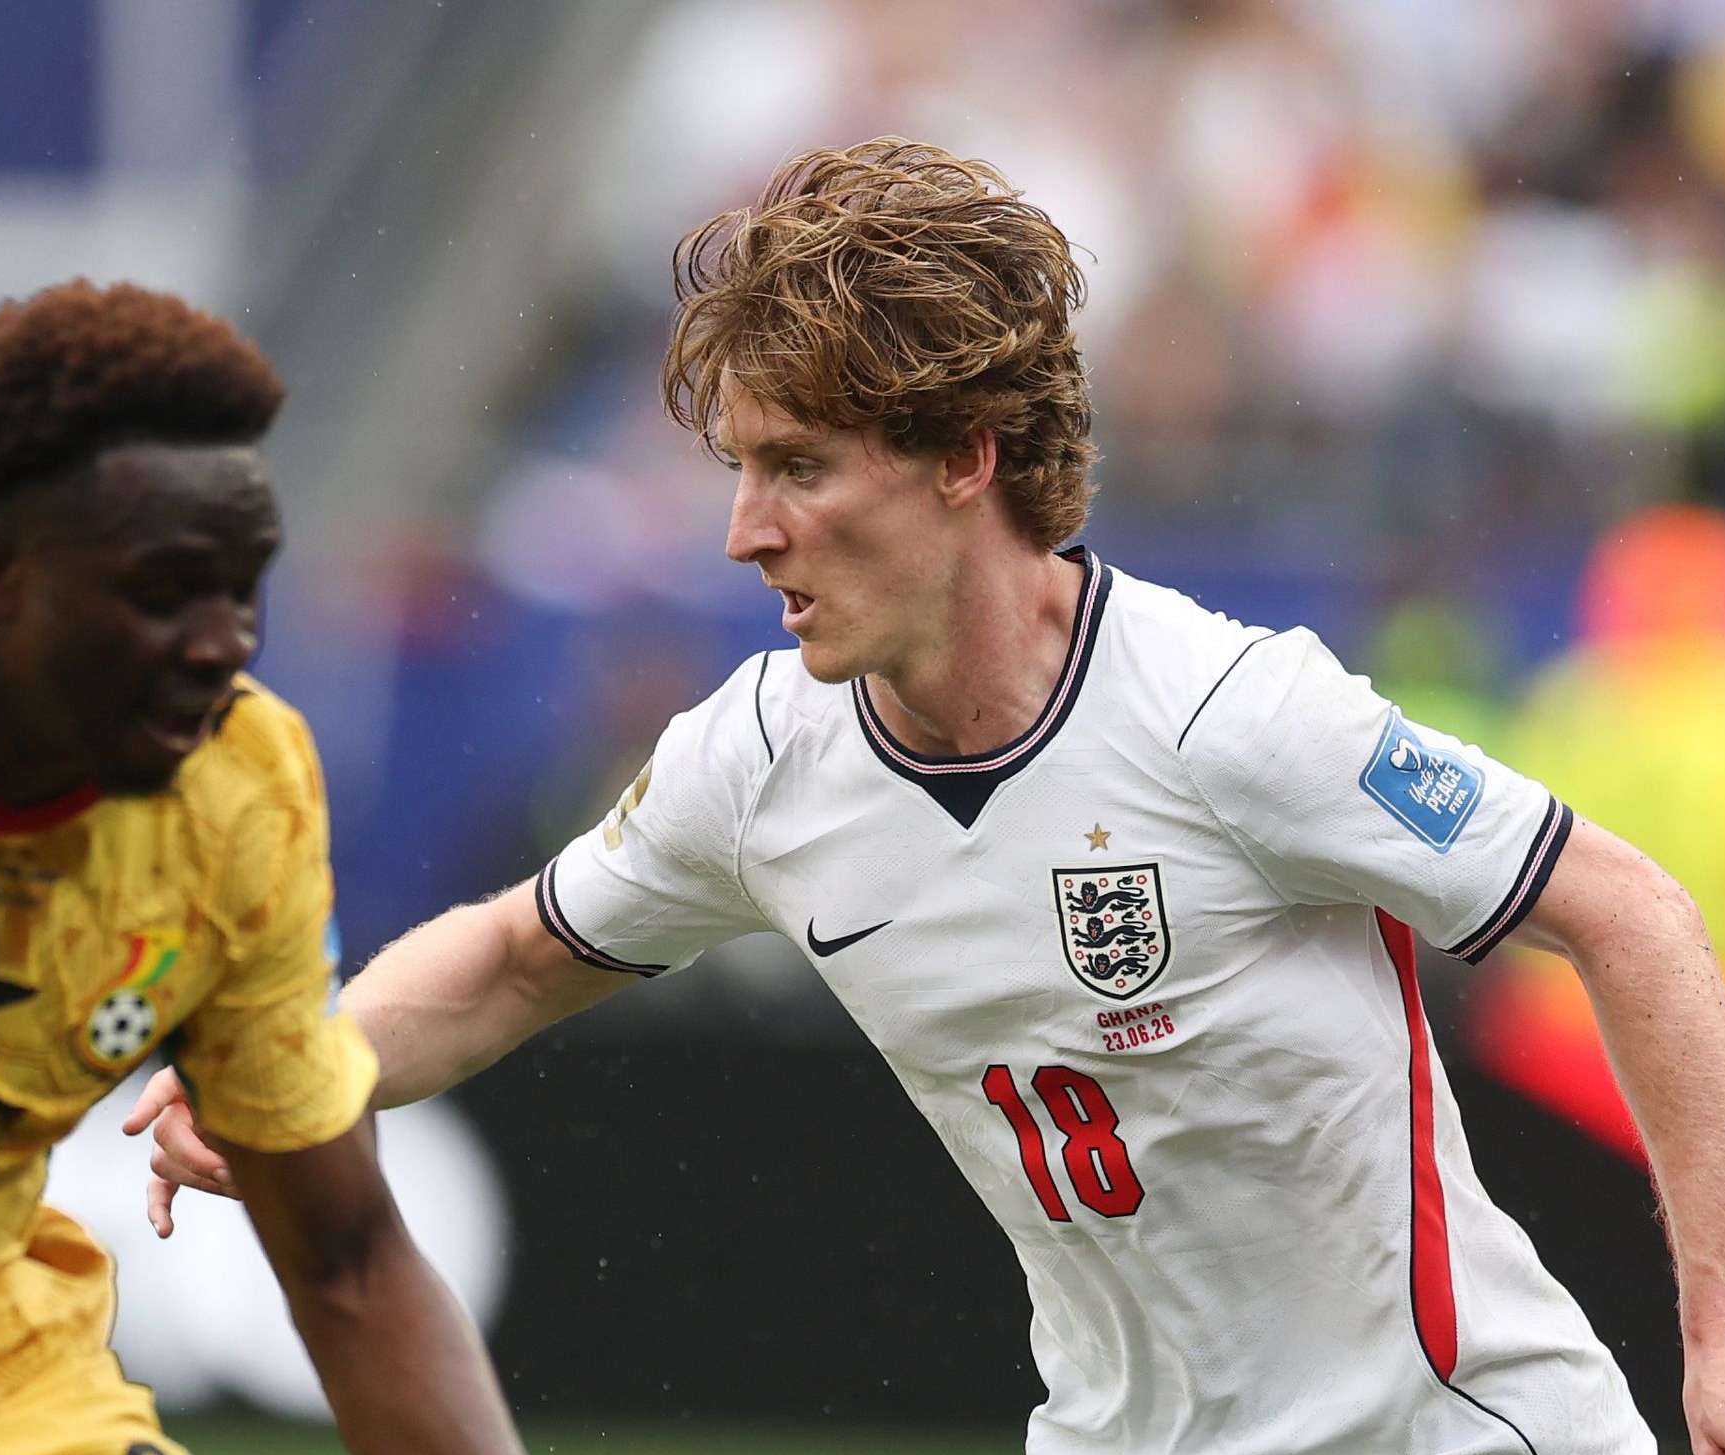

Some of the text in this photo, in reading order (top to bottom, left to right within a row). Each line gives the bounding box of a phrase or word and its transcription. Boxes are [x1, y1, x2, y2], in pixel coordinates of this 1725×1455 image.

[1425, 763, 1463, 815] PEACE
[1448, 788, 1469, 815] FIFA
[1096, 1002, 1165, 1029] GHANA
[1102, 1014, 1175, 1053] 23.06.26
[981, 1063, 1146, 1223] 18
